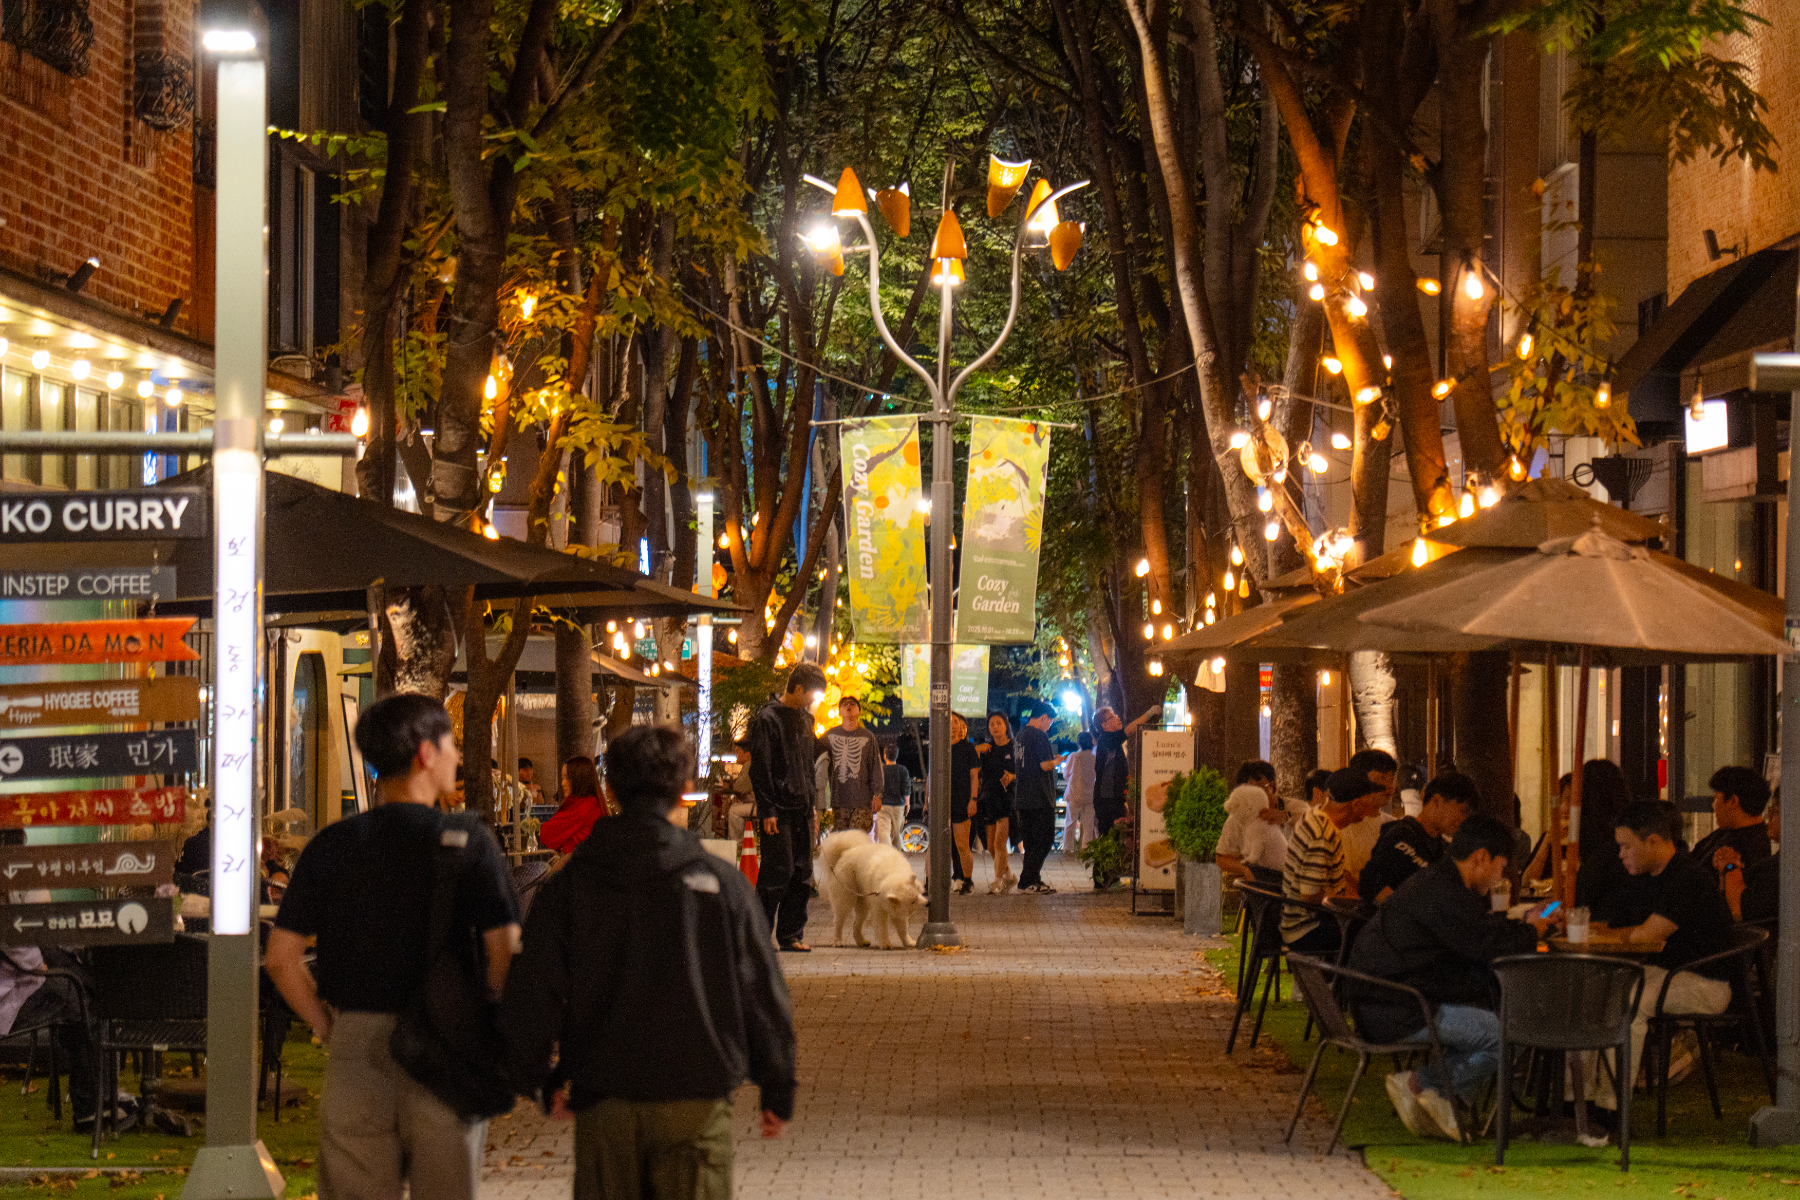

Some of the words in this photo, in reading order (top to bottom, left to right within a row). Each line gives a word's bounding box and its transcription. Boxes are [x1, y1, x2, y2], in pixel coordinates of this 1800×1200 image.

[850, 443, 871, 497] Cozy
[1, 500, 52, 533] KO
[62, 498, 189, 532] CURRY
[856, 501, 878, 580] Garden
[3, 574, 69, 596] INSTEP
[77, 573, 151, 595] COFFEE
[976, 574, 1010, 597] Cozy
[972, 595, 1021, 615] Garden
[0, 634, 54, 658] ERIA
[61, 632, 92, 653] DA
[44, 691, 92, 711] HYGGEE
[92, 689, 140, 708] COFFEE
[957, 694, 980, 703] Garden
[959, 685, 974, 694] Cozy
[127, 738, 178, 767] 민가
